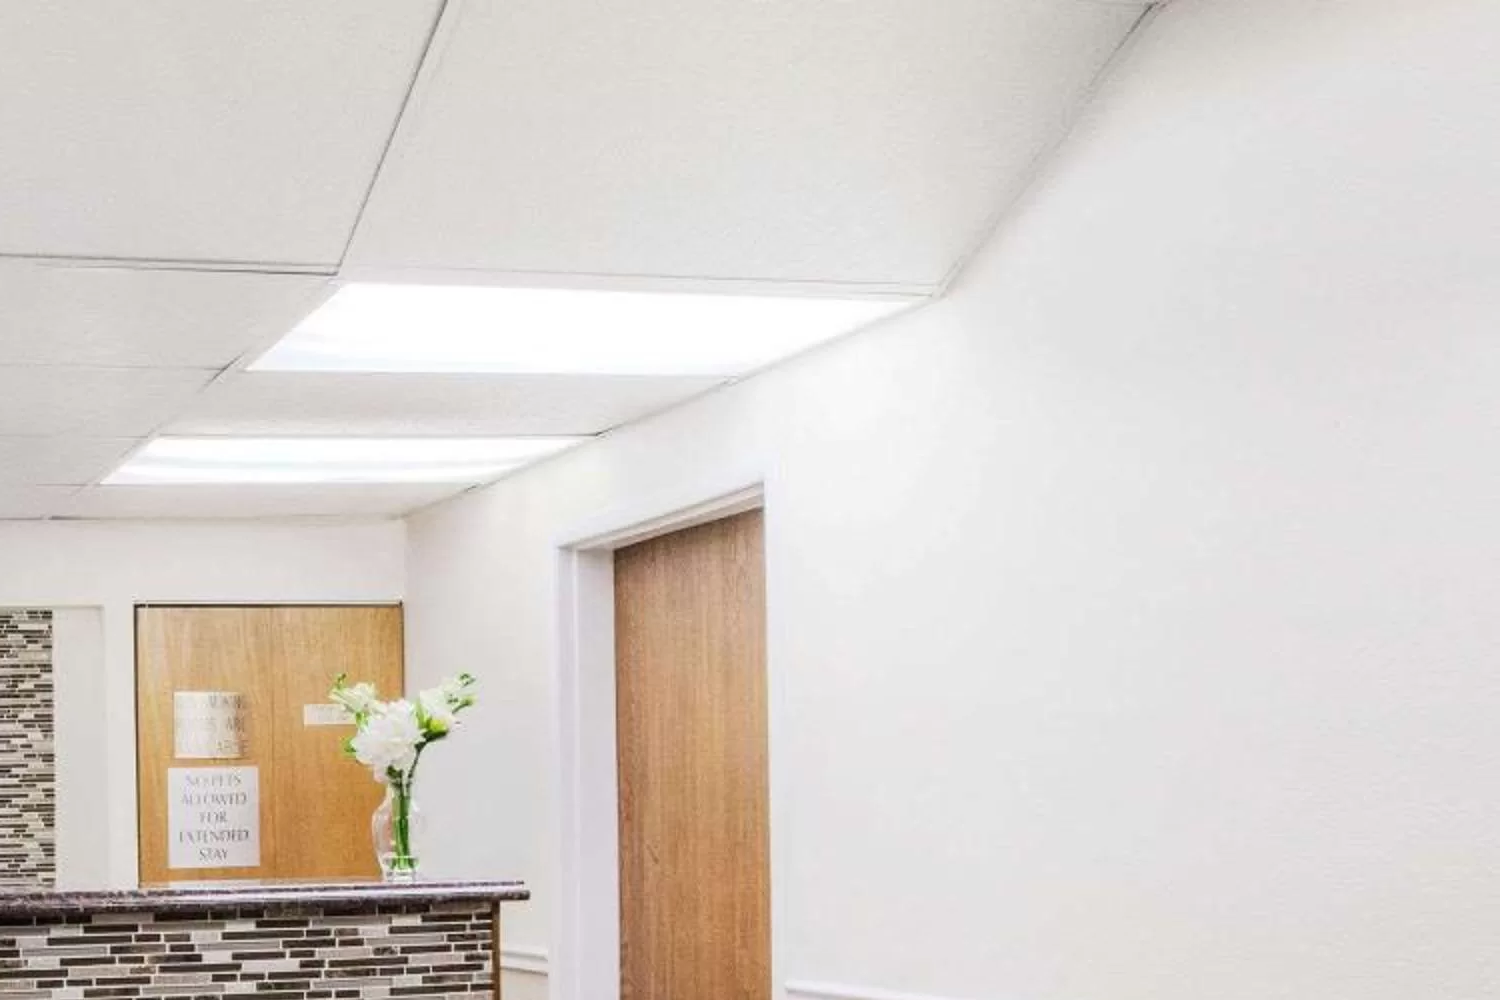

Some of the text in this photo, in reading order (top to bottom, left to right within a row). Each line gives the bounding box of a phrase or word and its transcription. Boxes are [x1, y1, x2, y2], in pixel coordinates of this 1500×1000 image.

[200, 812, 228, 824] FOR
[179, 830, 250, 844] EXTENDED
[199, 848, 228, 861] STAY
